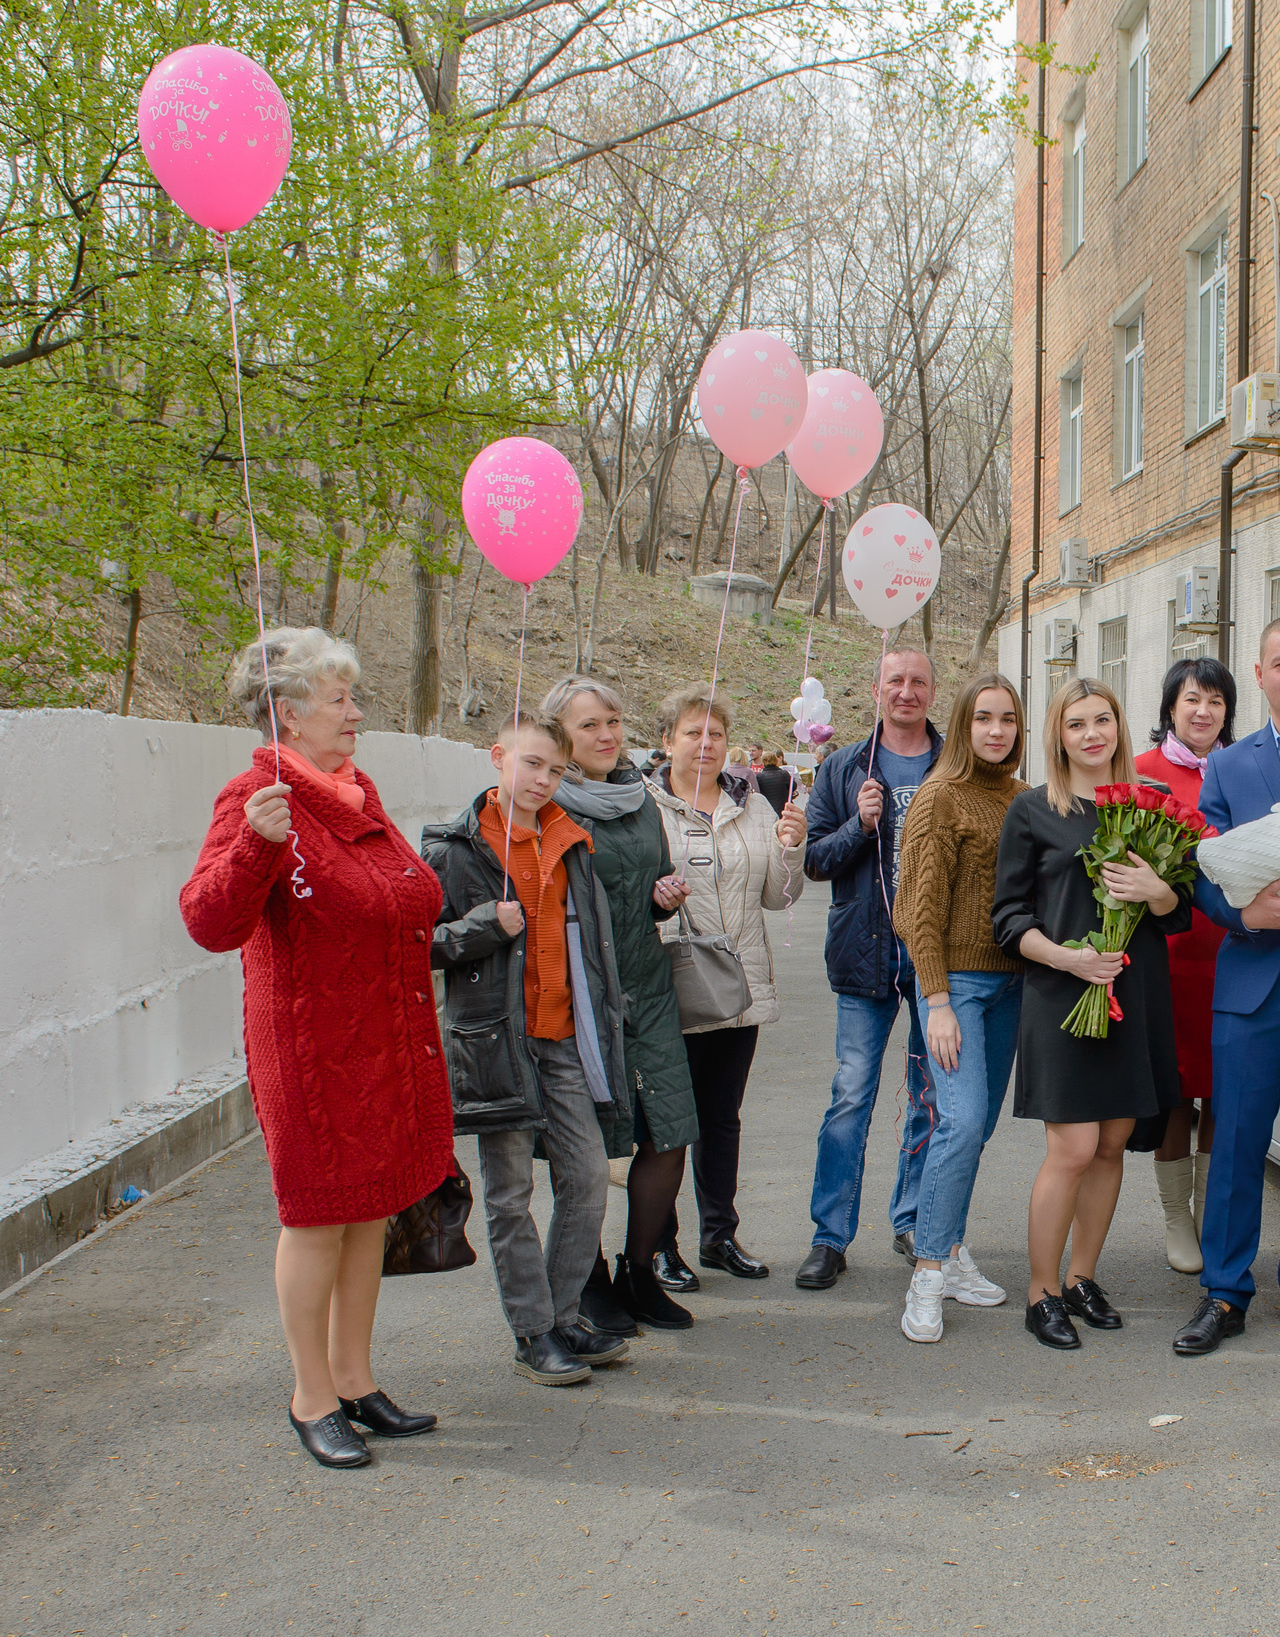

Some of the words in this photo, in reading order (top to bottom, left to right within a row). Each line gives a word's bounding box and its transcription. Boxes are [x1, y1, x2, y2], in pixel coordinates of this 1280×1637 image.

[756, 391, 801, 410] ДОЧКИ
[816, 424, 865, 440] ДОЧКИ
[891, 574, 932, 587] ДОЧКИ
